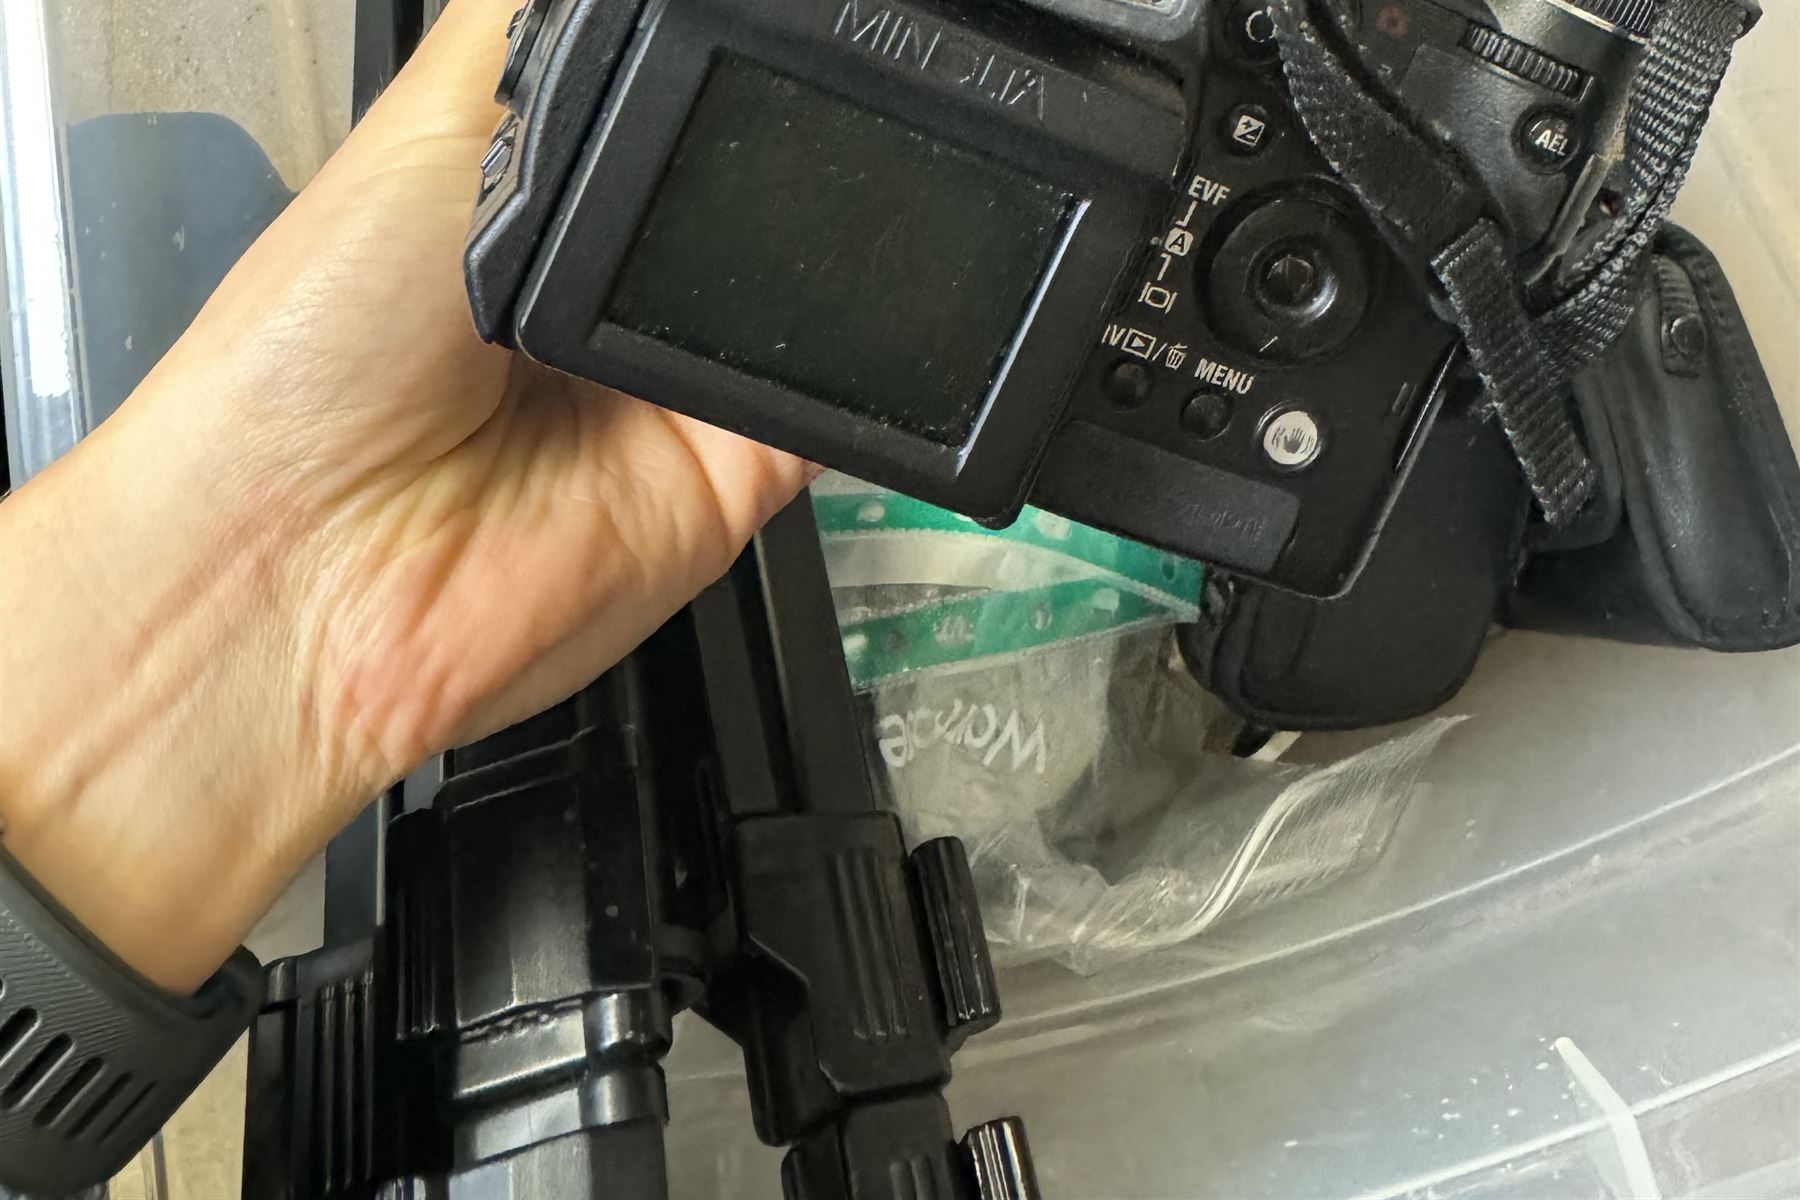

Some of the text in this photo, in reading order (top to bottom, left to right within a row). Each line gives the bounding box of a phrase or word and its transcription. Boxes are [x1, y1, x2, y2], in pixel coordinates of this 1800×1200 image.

[1534, 128, 1569, 157] AEL
[1187, 174, 1231, 206] EVF
[1193, 357, 1255, 395] MENU
